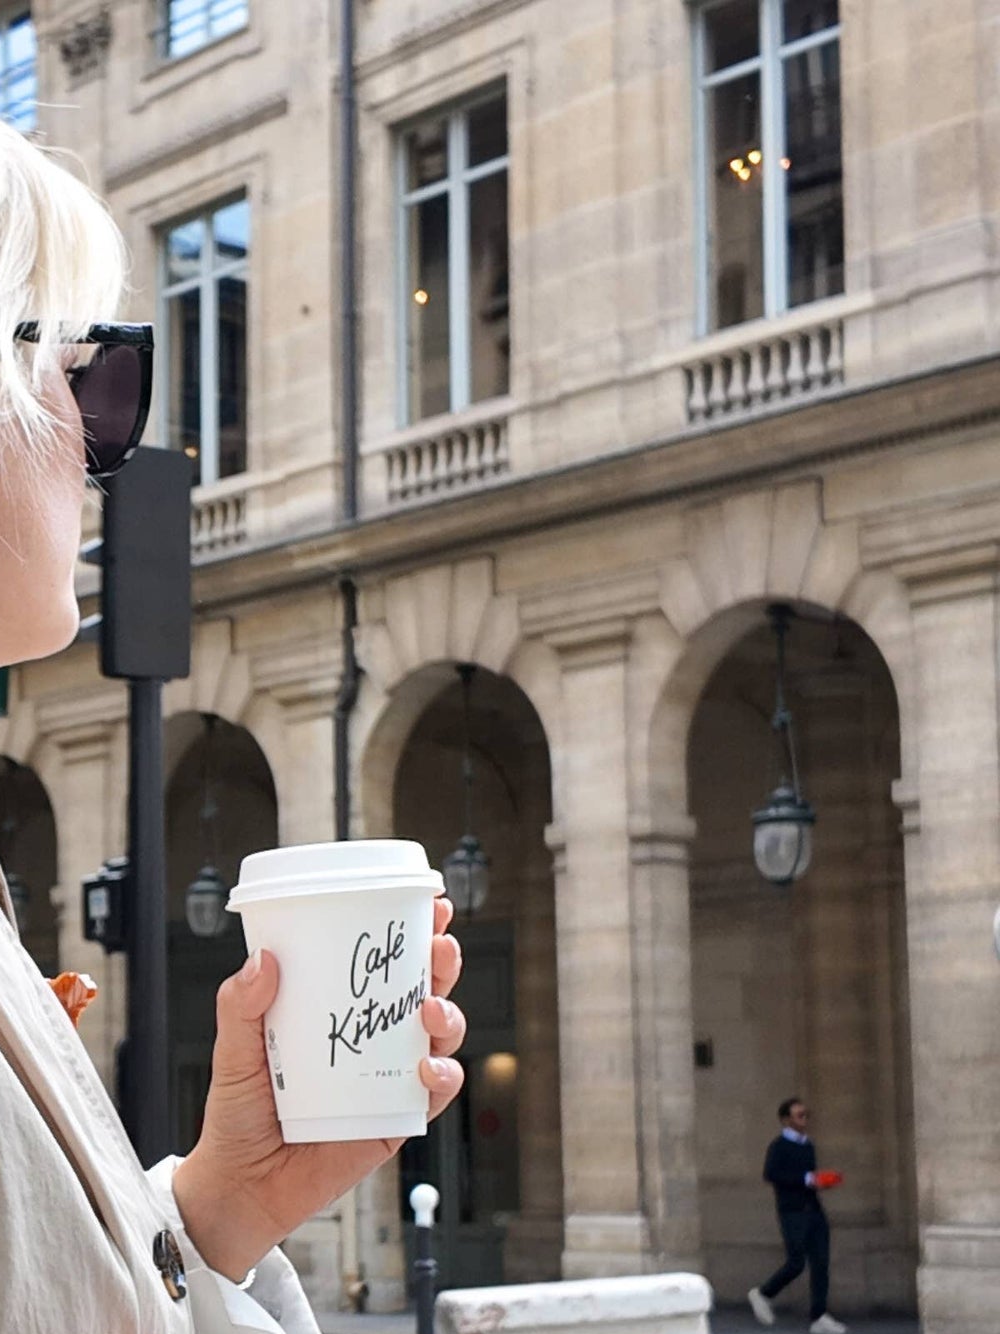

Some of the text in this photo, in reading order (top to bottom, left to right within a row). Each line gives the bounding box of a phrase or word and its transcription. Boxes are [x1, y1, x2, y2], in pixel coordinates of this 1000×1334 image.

[351, 920, 404, 999] Café
[328, 968, 426, 1067] Kitsuné
[375, 1068, 402, 1078] PARIS
